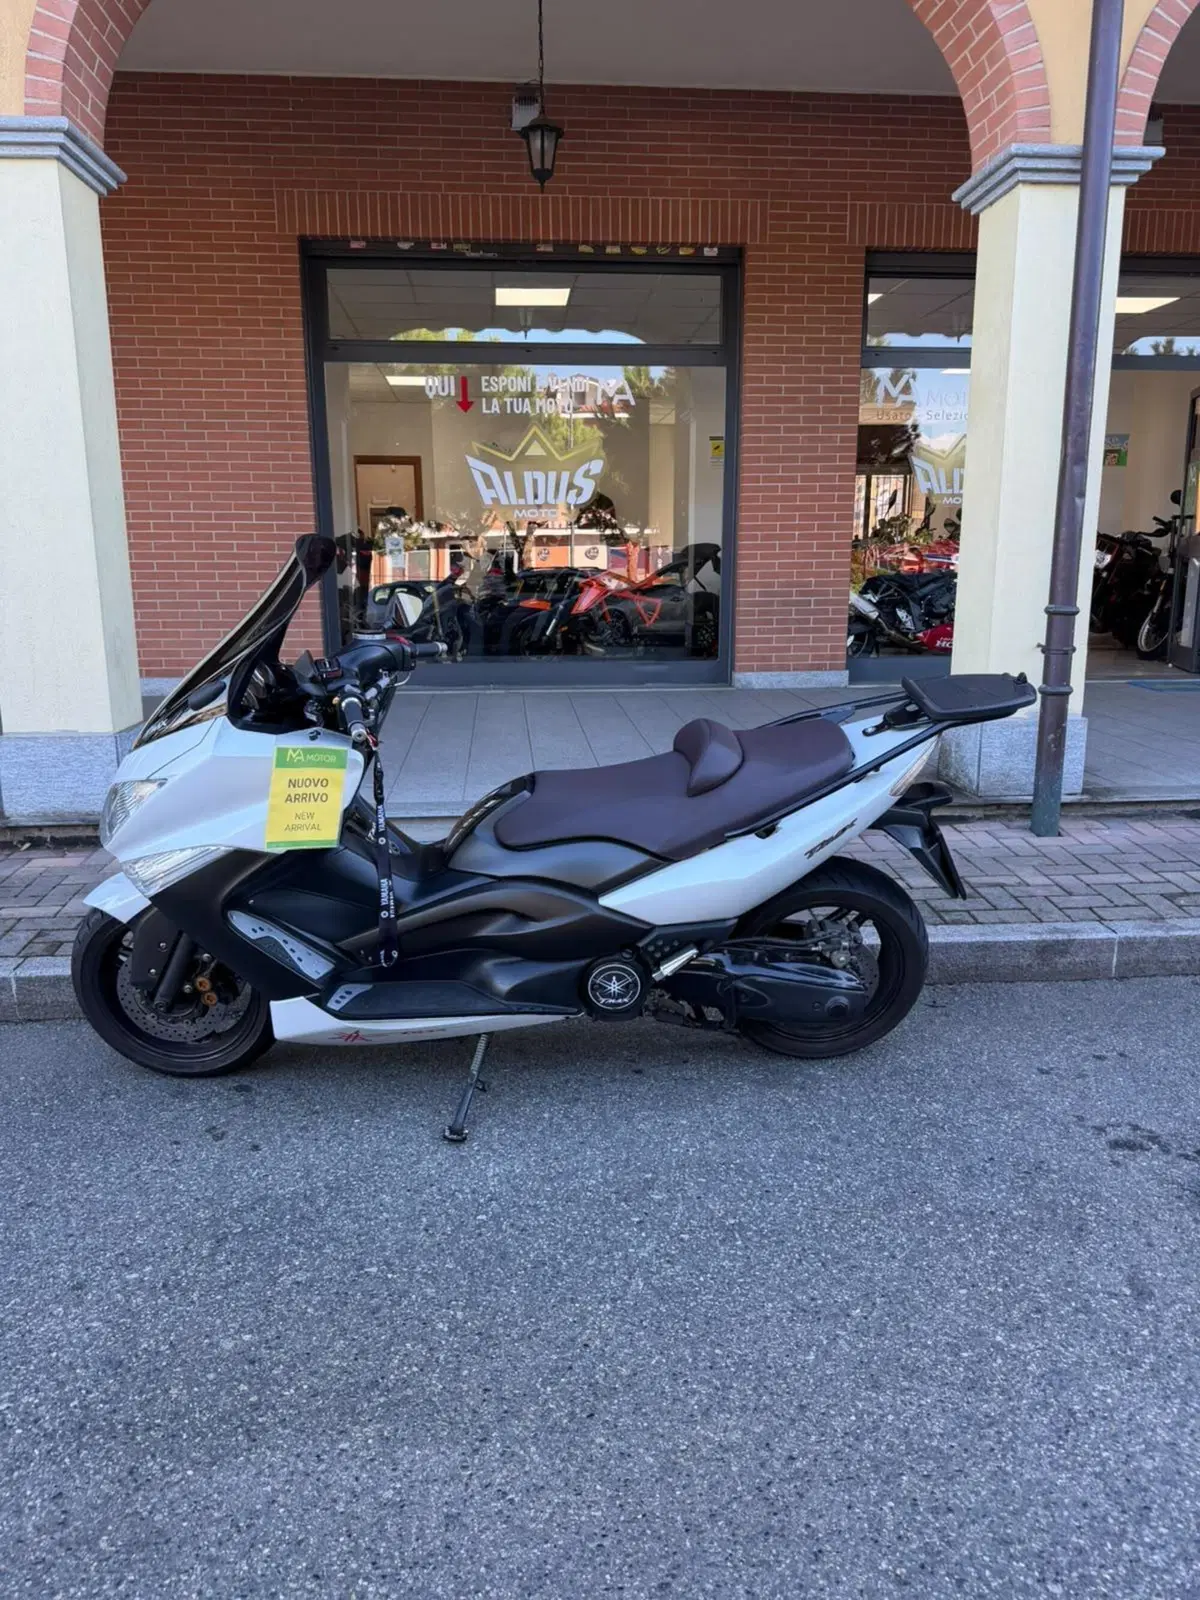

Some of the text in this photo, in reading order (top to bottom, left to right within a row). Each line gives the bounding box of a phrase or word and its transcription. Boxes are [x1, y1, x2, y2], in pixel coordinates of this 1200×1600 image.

[424, 375, 456, 399] QUI
[481, 375, 531, 393] ESPONI
[547, 375, 590, 393] VENDI
[481, 398, 574, 414] LA TUA MOTO
[876, 410, 911, 420] Usato
[464, 454, 604, 505] ALDUS
[306, 754, 337, 764] MOTOR
[287, 778, 329, 789] NUOVO
[284, 792, 329, 804] ARRIVO
[294, 811, 315, 821] NEW
[377, 804, 386, 833] YAMAHA
[284, 823, 323, 832] ARRIVAL
[380, 878, 389, 907] YAMAHA
